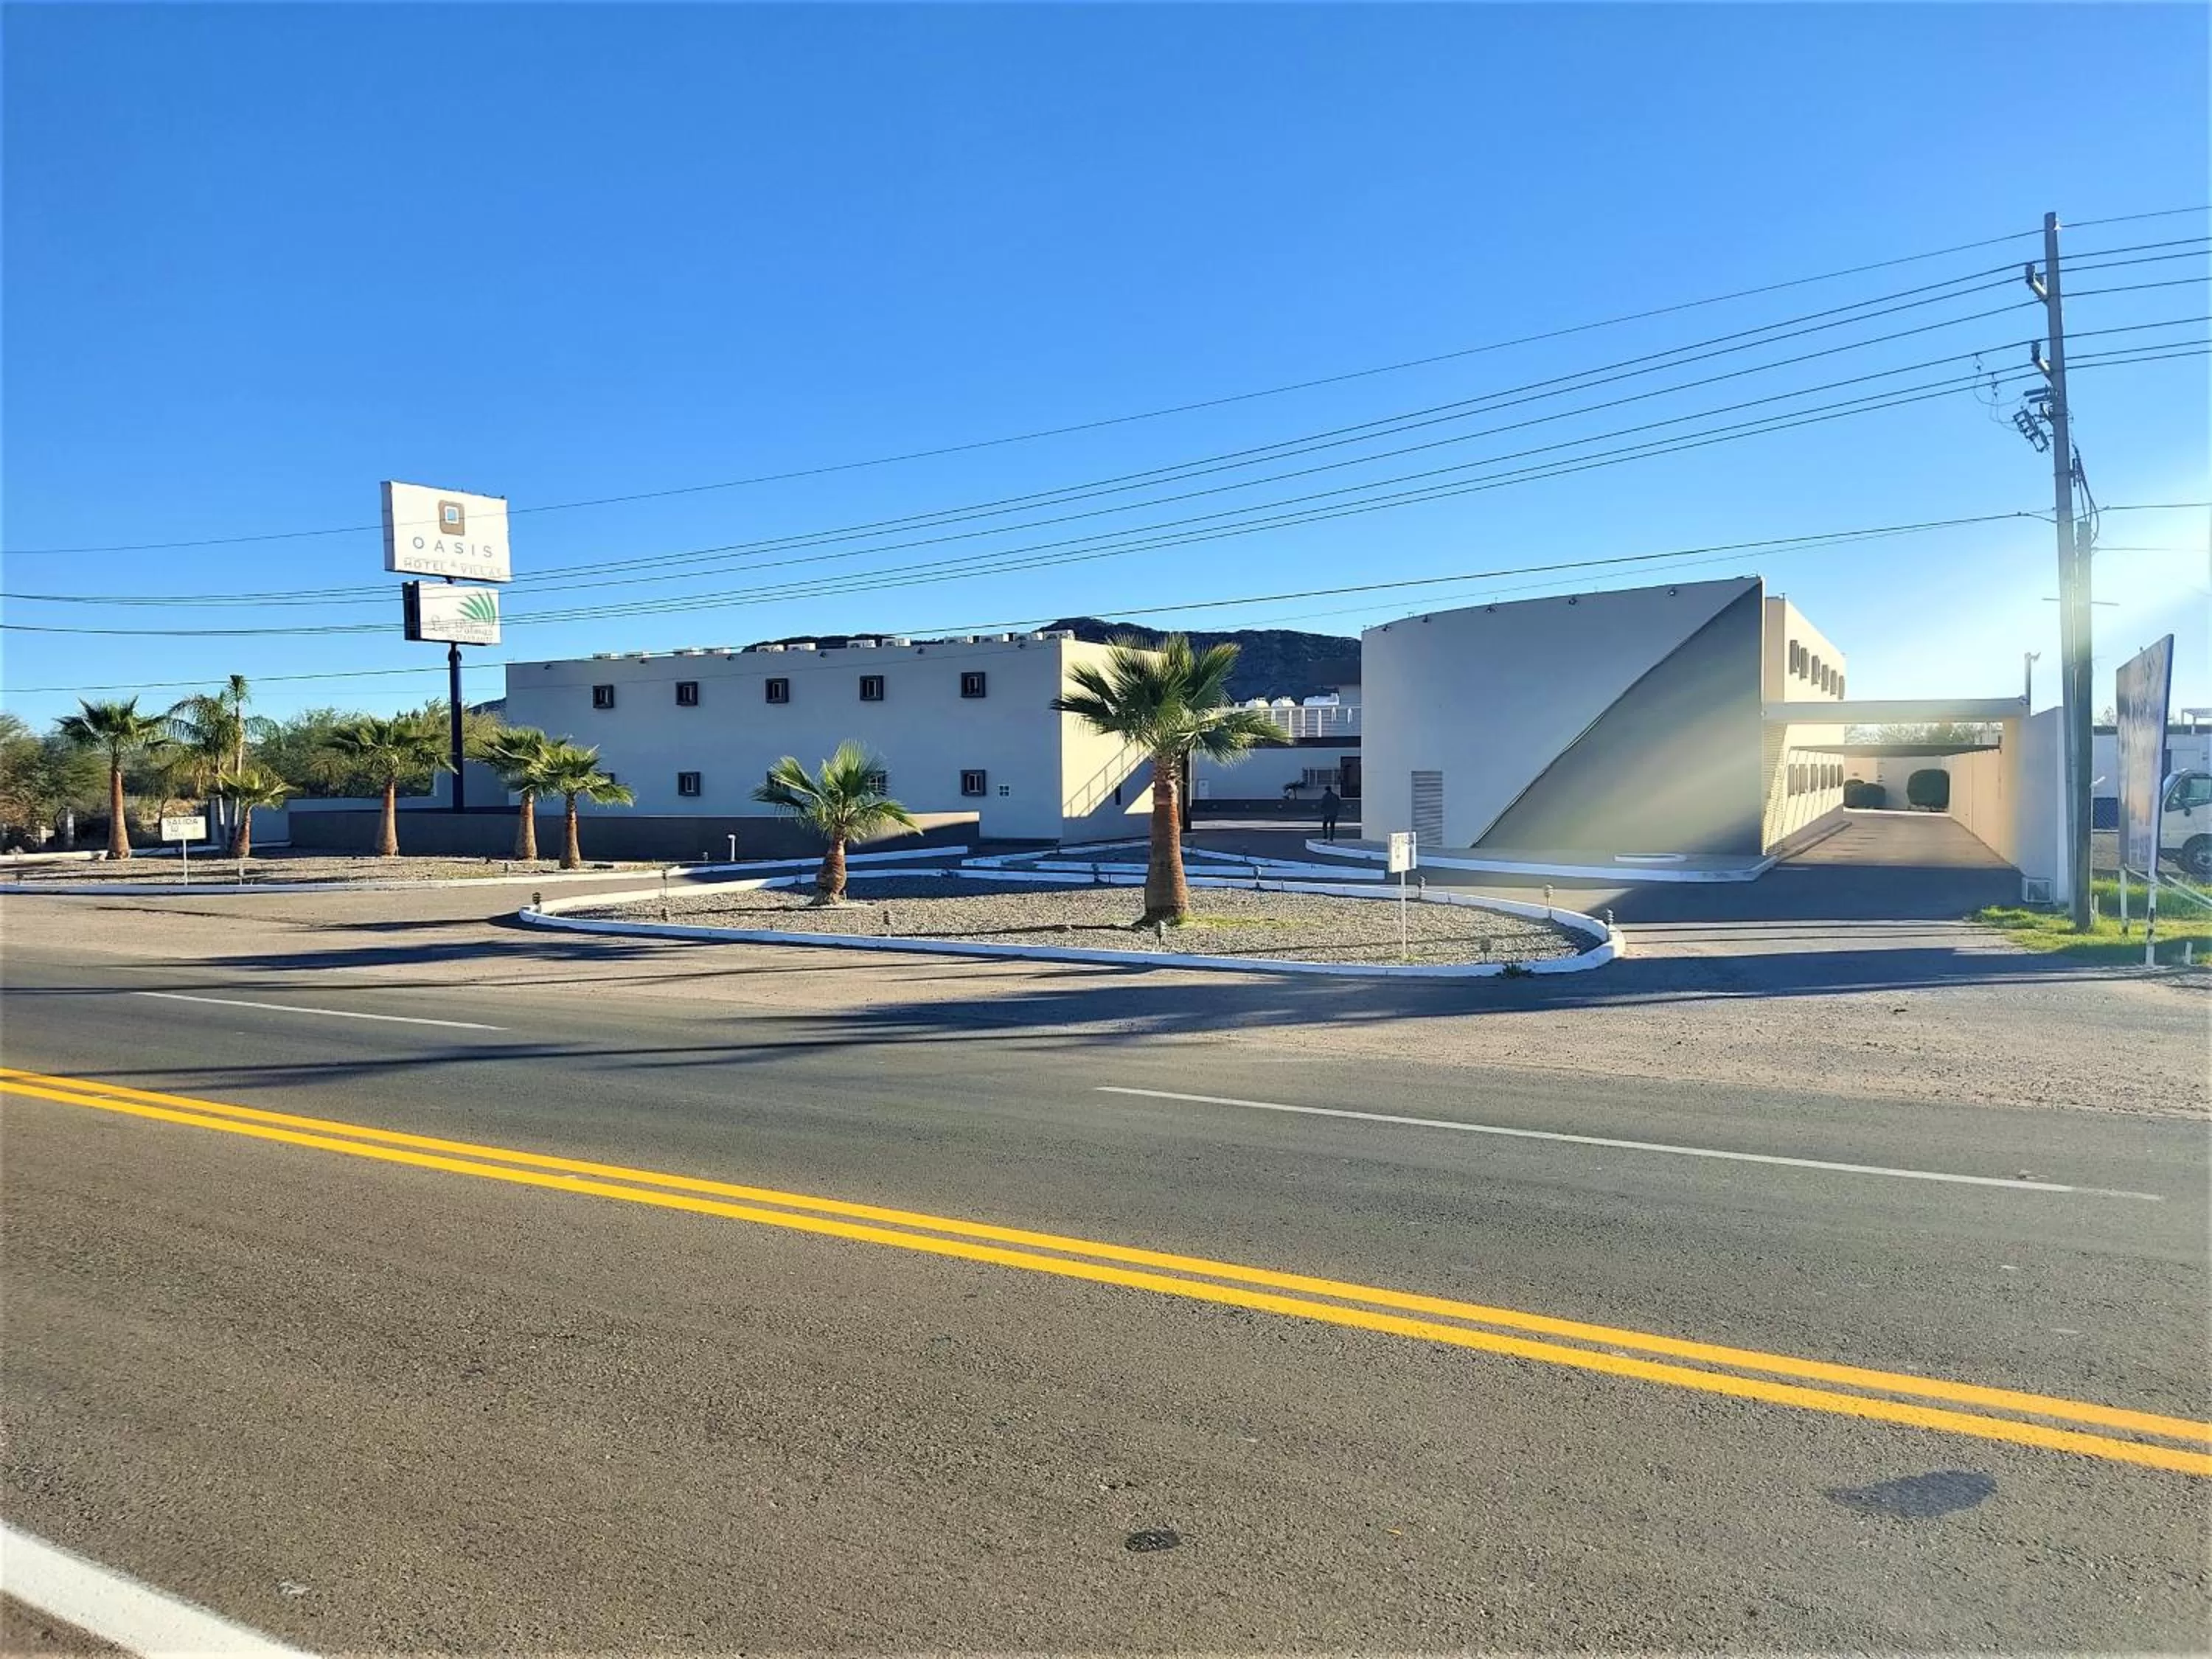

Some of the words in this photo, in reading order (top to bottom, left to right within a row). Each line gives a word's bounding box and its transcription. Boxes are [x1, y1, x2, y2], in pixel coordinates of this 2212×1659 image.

[412, 536, 493, 558] OASIS
[403, 558, 448, 573] HOTEL
[166, 818, 198, 826] SALIDA
